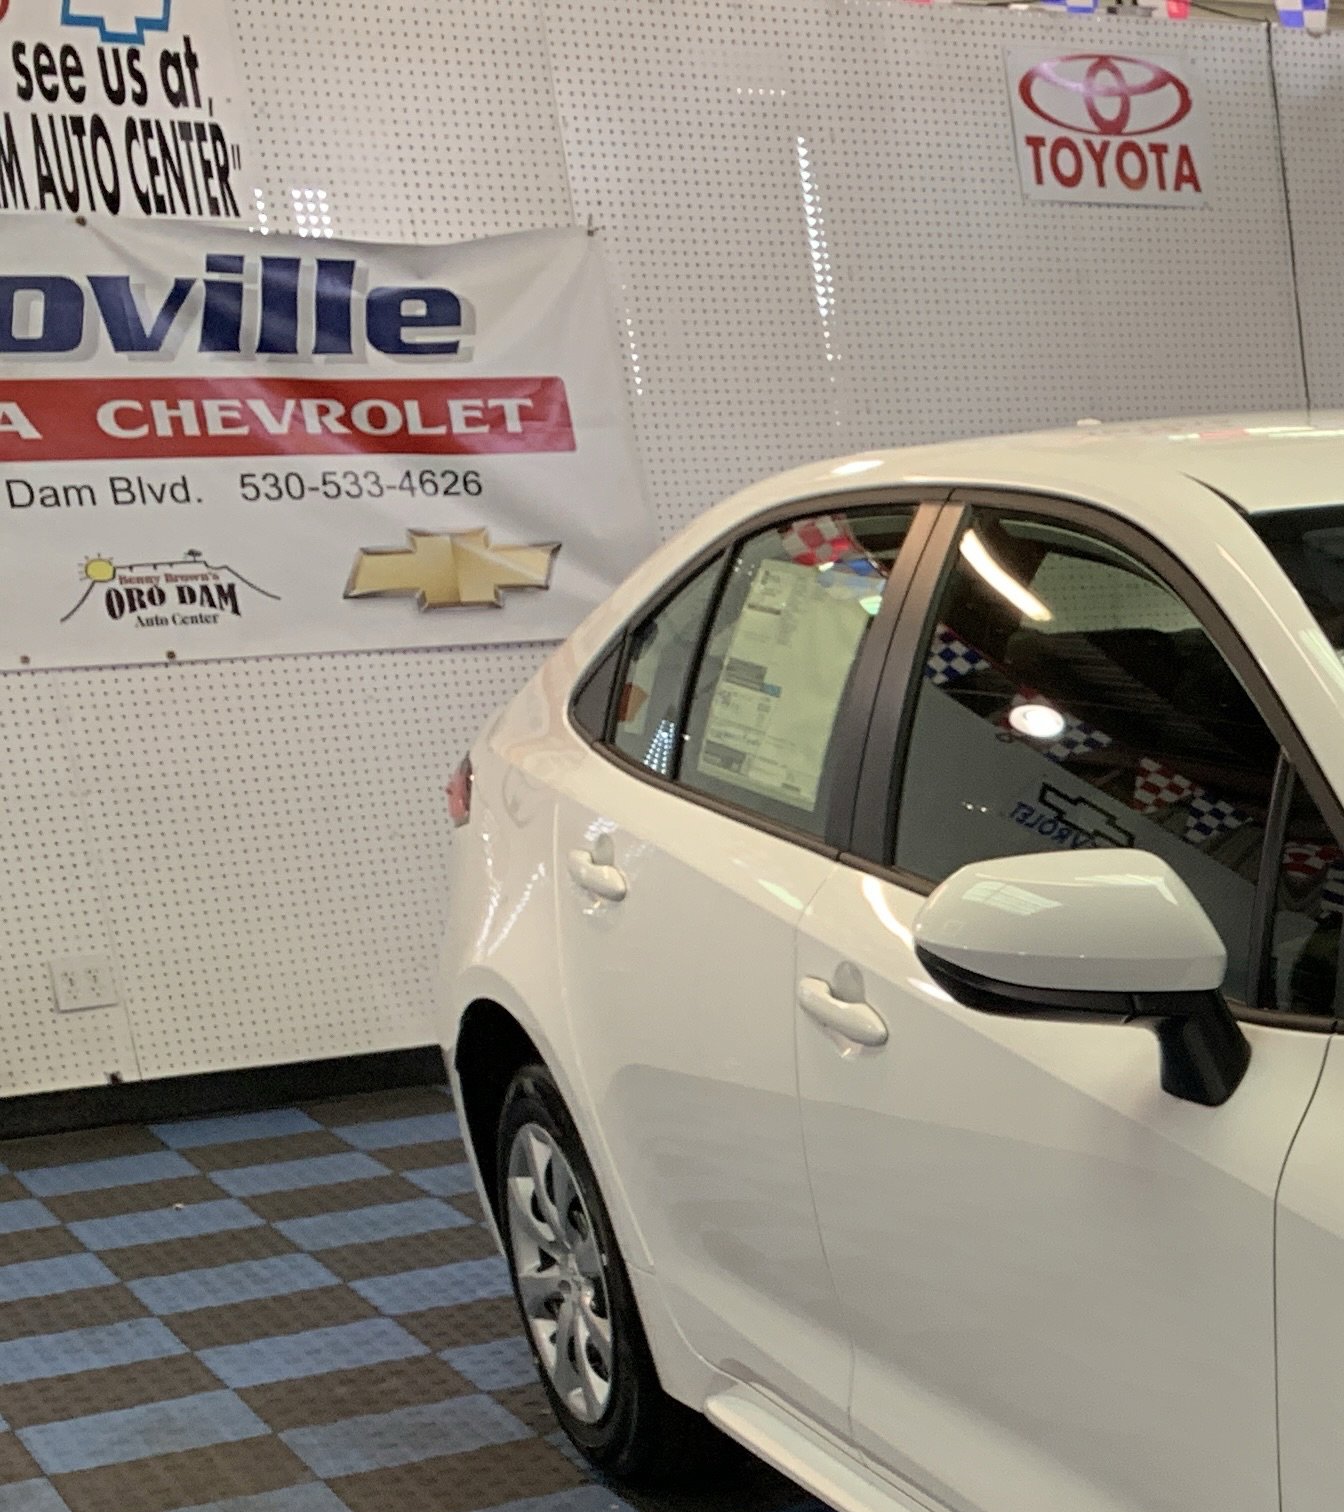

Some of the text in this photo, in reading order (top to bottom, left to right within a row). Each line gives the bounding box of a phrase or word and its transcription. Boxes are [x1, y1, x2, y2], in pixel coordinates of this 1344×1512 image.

[12, 40, 86, 103] see
[97, 46, 148, 107] us
[31, 112, 121, 216] AUTO
[125, 115, 241, 218] CENTER"
[1024, 134, 1202, 193] TOYOTA
[96, 397, 534, 440] CHEVROLET
[5, 469, 483, 509] Dam Blvd. 530-533-4626
[105, 582, 241, 621] ORO DAM
[135, 612, 220, 628] Auto Center
